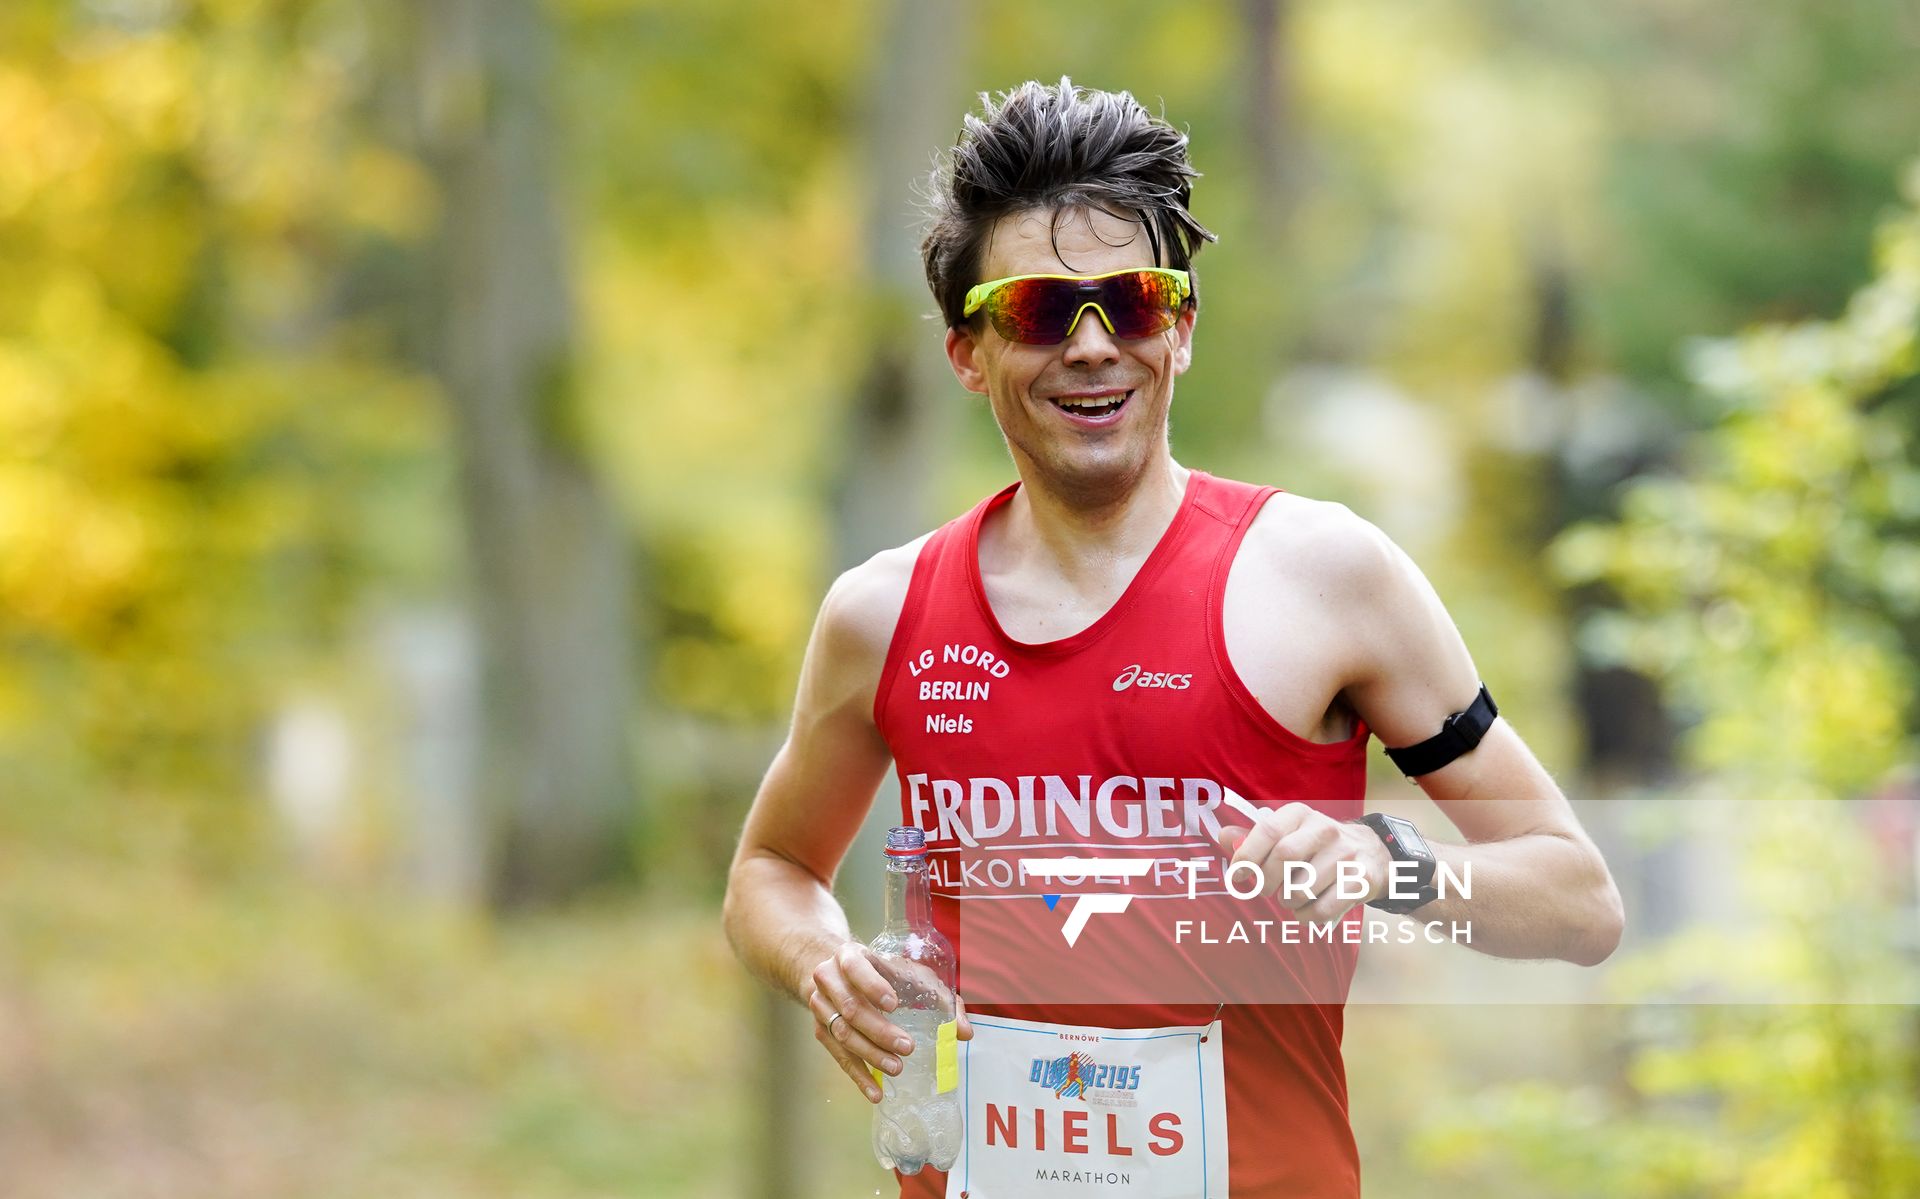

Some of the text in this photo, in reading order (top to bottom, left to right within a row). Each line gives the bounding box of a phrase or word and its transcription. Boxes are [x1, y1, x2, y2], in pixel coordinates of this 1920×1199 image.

[908, 644, 1010, 678] LG NORD
[919, 680, 990, 701] BERLIN
[926, 713, 973, 734] Niels
[906, 772, 1221, 848] ERDINGER
[1059, 1033, 1100, 1043] BERNÖWE
[986, 1103, 1184, 1157] NIELS
[1036, 1168, 1131, 1185] MARATHON
